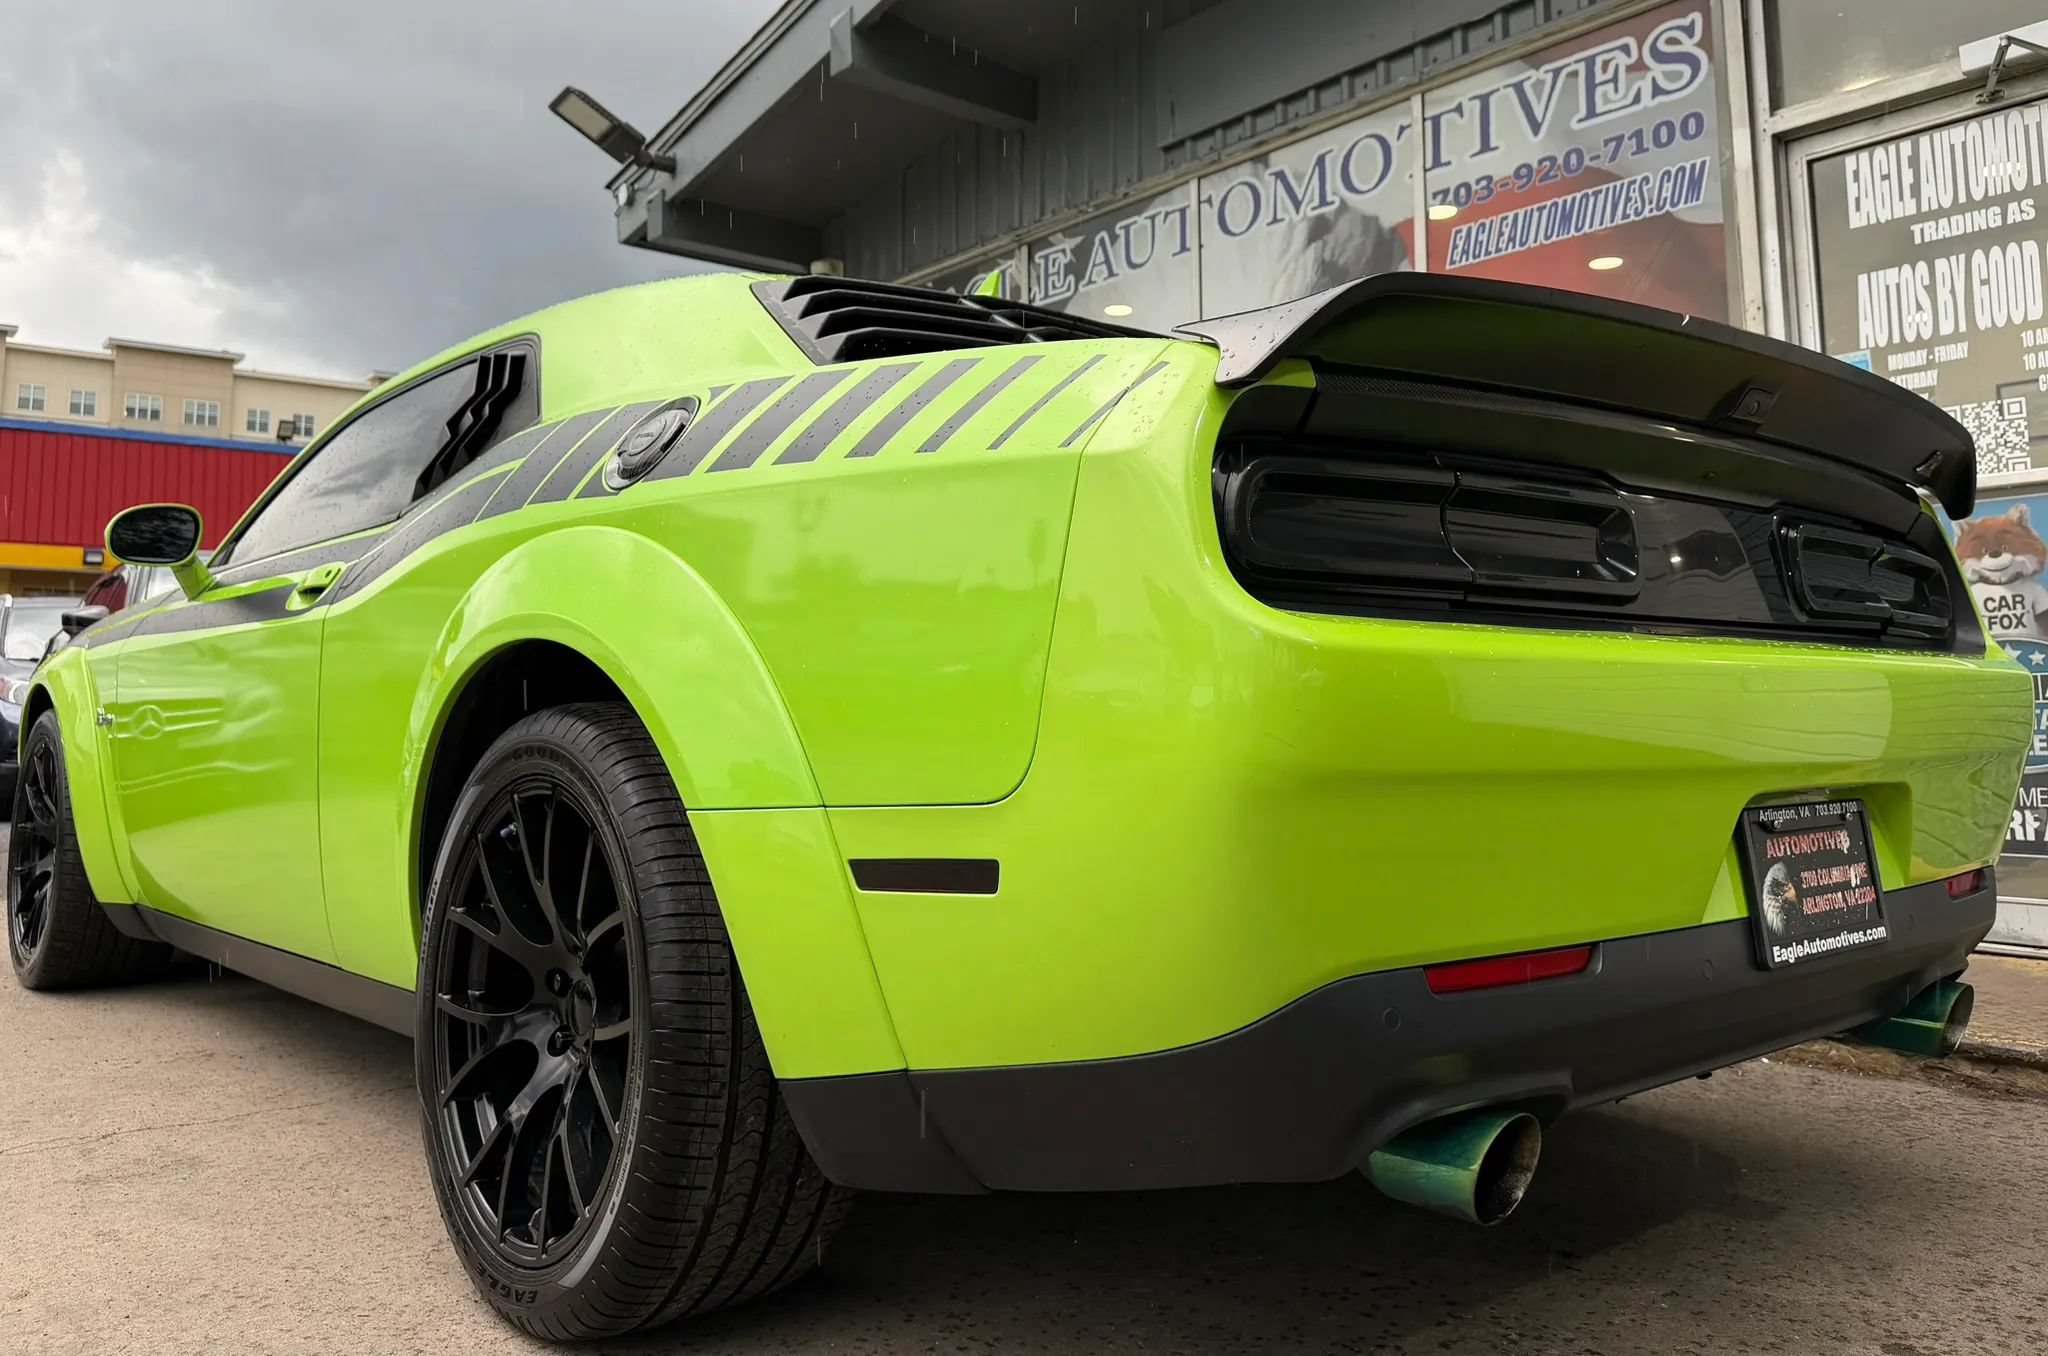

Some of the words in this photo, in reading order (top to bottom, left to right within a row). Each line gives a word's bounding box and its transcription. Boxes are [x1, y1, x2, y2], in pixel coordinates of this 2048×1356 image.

[1083, 16, 1705, 286] AUTOMOTIVES
[1431, 110, 1706, 208] 703-920-7100
[1845, 141, 1917, 229] EAGLE
[1446, 157, 1711, 271] EAGLEAUTOMOTIVES.COM
[1910, 206, 2002, 245] TRADING
[2007, 198, 2036, 226] AS
[1857, 260, 1934, 350] AUTOS
[1934, 253, 1968, 336] BY
[1971, 240, 2043, 331] GOOD
[1887, 348, 1928, 371] MONDAY
[1934, 341, 1969, 363] FRIDAY
[2020, 329, 2035, 348] 10
[2022, 352, 2037, 371] 10
[1984, 594, 2025, 613] CAR
[1988, 612, 2027, 631] FOX
[1759, 808, 1798, 823] Arlington,
[1798, 806, 1811, 818] VA
[1844, 889, 1857, 907] VA
[1772, 925, 1887, 964] EagleAutomotives.com
[475, 1263, 539, 1304] EAGLE
